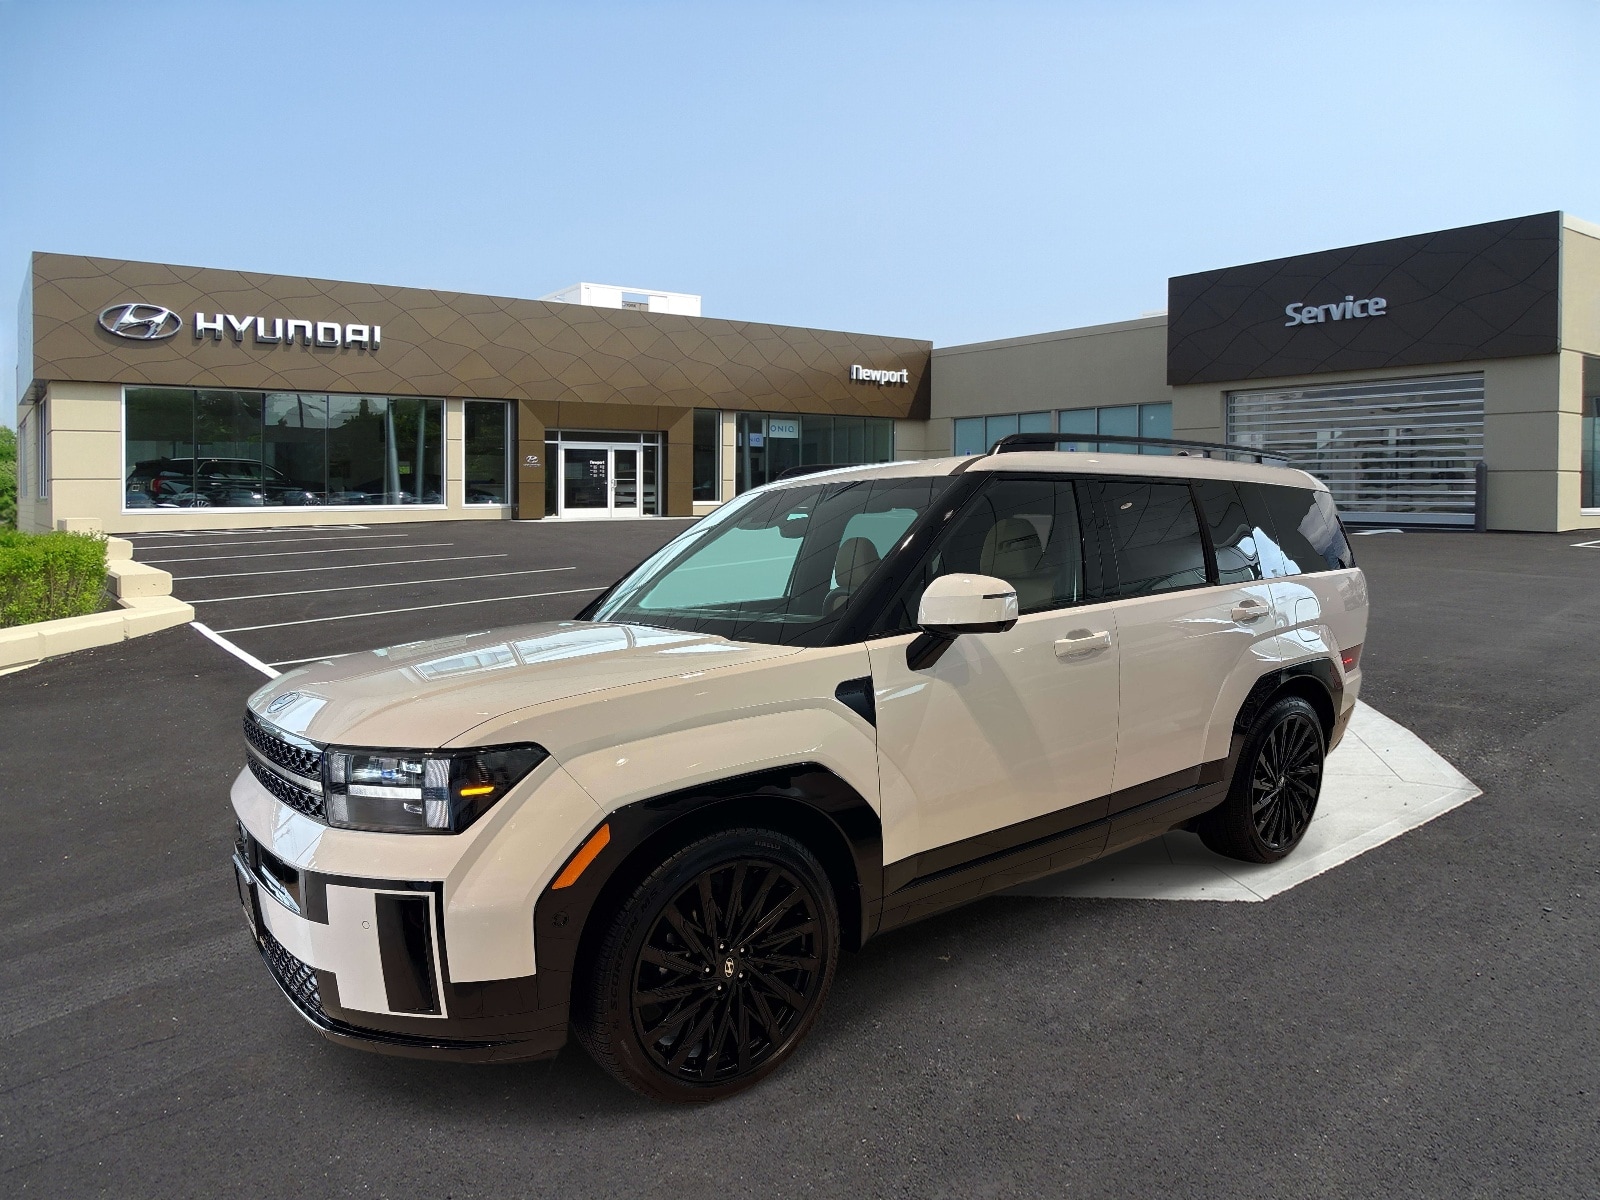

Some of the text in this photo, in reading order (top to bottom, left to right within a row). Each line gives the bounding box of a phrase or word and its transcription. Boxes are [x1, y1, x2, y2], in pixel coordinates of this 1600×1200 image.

[1285, 295, 1387, 327] Service
[194, 312, 381, 350] HYUNDAI
[770, 424, 795, 433] ONIQ
